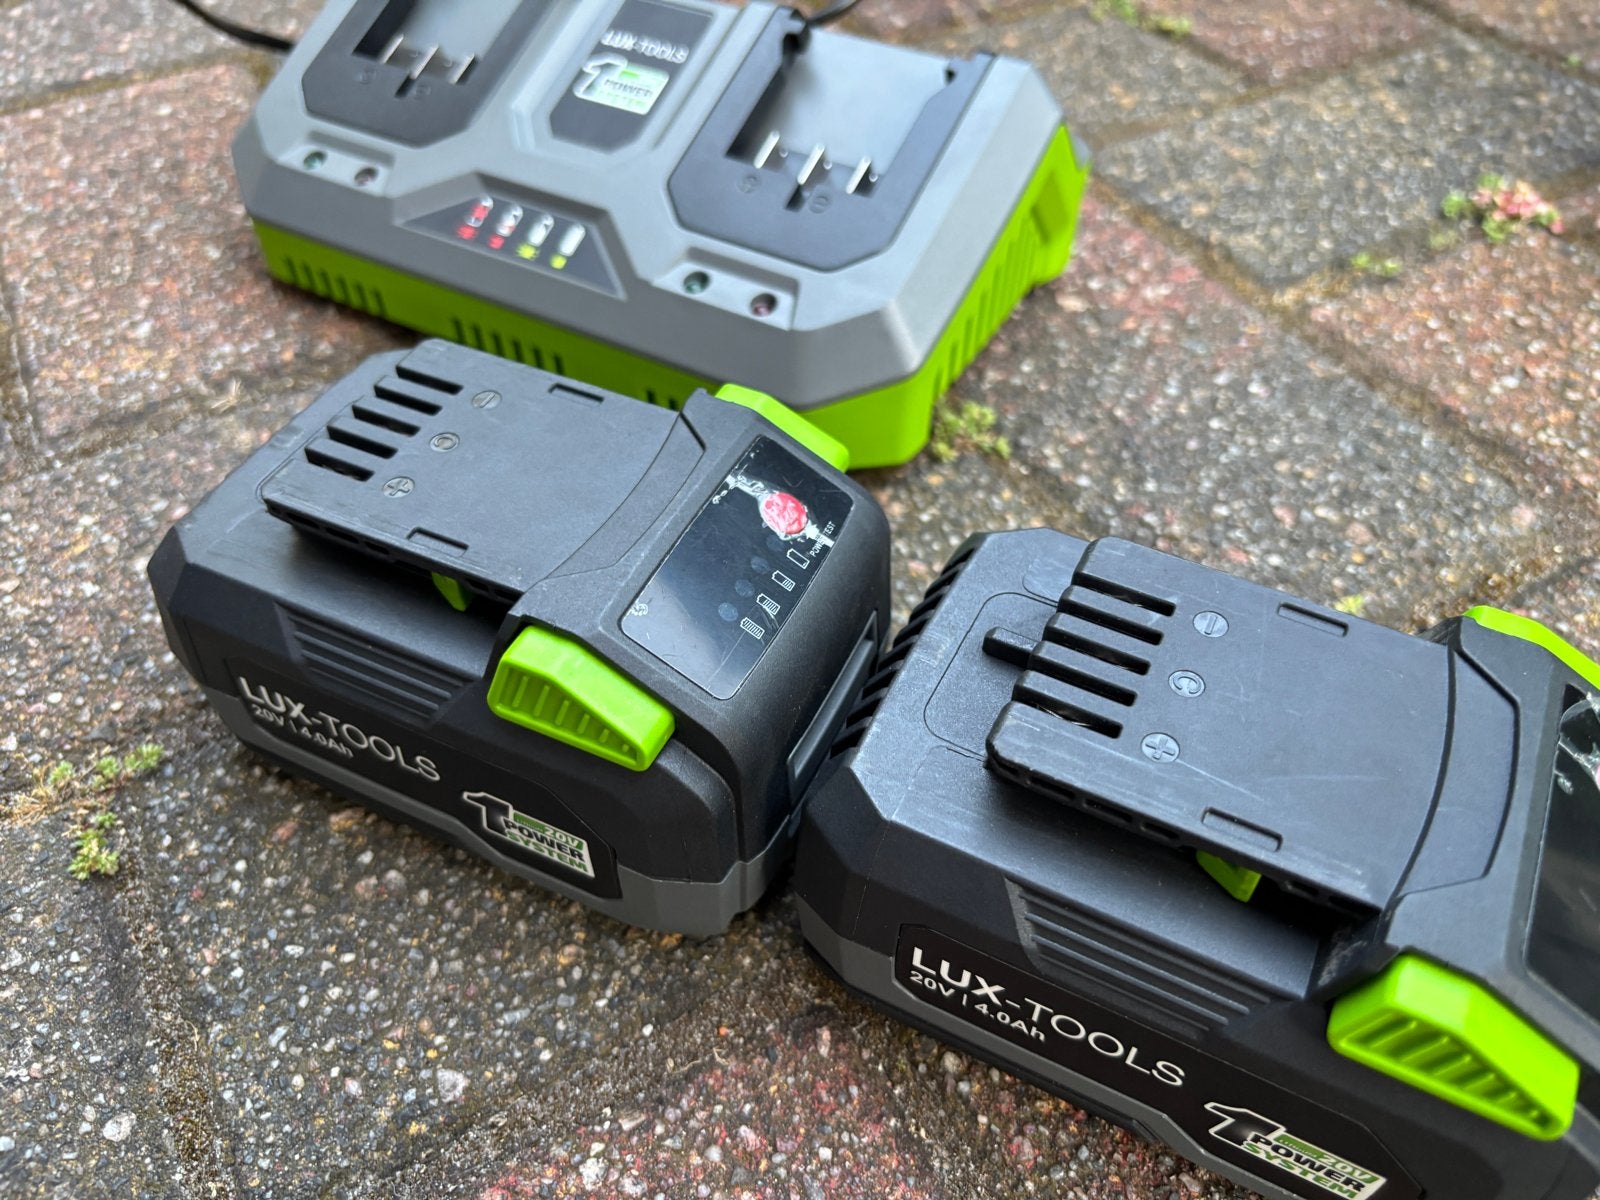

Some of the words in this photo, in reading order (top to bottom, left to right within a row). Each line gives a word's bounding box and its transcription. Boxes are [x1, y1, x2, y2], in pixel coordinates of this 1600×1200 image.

[822, 521, 836, 537] TEST
[239, 676, 440, 781] LUX-TOOLS
[251, 703, 285, 727] 20V
[502, 817, 587, 863] POWER
[506, 830, 588, 872] SYSTEM
[544, 826, 583, 849] 20V
[909, 970, 956, 997] 20V
[974, 1002, 1046, 1043] 4.0Ah
[911, 946, 1186, 1087] LUX-TOOLS
[1242, 1142, 1359, 1199] SYSTEM
[1249, 1133, 1366, 1192] POWER
[1318, 1153, 1372, 1184] 20V
